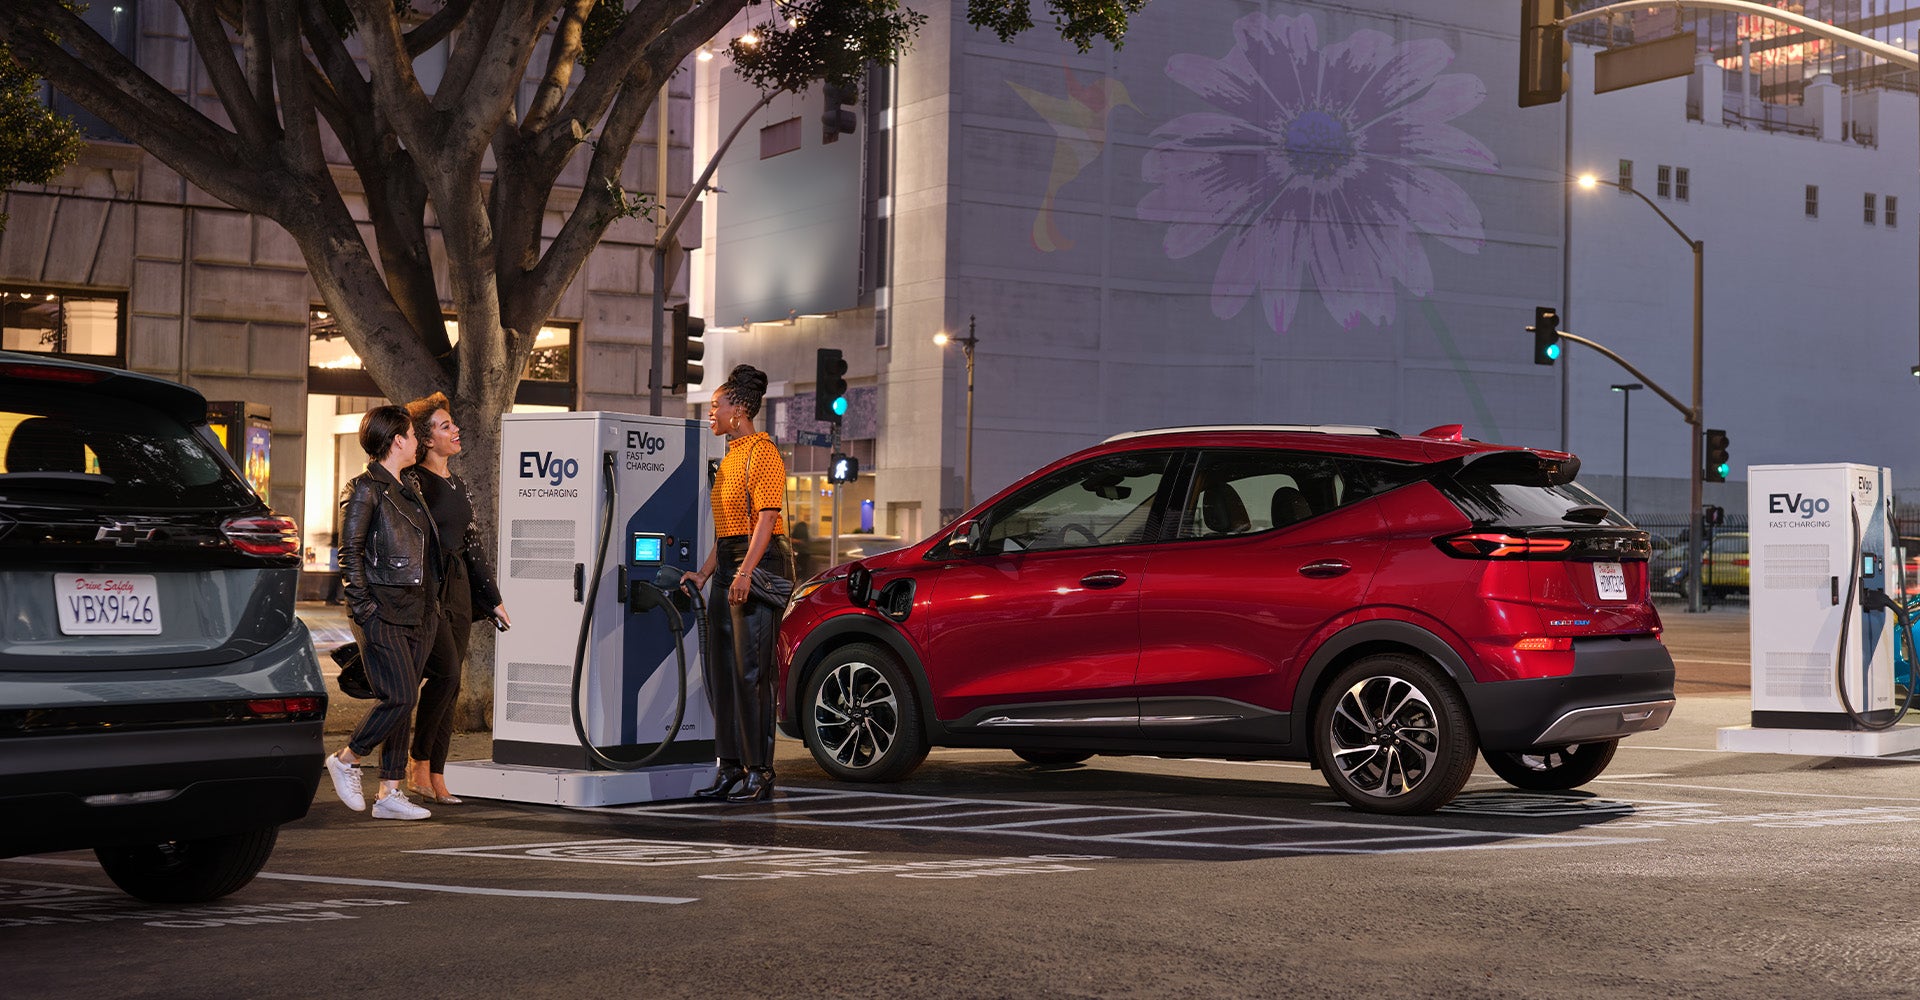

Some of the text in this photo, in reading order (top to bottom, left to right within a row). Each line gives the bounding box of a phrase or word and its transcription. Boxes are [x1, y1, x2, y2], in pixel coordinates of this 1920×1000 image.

[627, 430, 665, 455] EVgo
[626, 452, 644, 460] FAST
[519, 451, 579, 487] EVgo
[626, 461, 665, 473] CHARGING
[518, 488, 578, 498] FAST CHARGING
[1858, 476, 1873, 494] EVgo
[1769, 493, 1830, 519] EVgo
[1789, 520, 1831, 528] CHARGING
[75, 578, 135, 594] Drive Safely
[69, 595, 153, 624] VBX9426
[697, 853, 1117, 880] CHARGING
[895, 864, 1097, 879] ONLY
